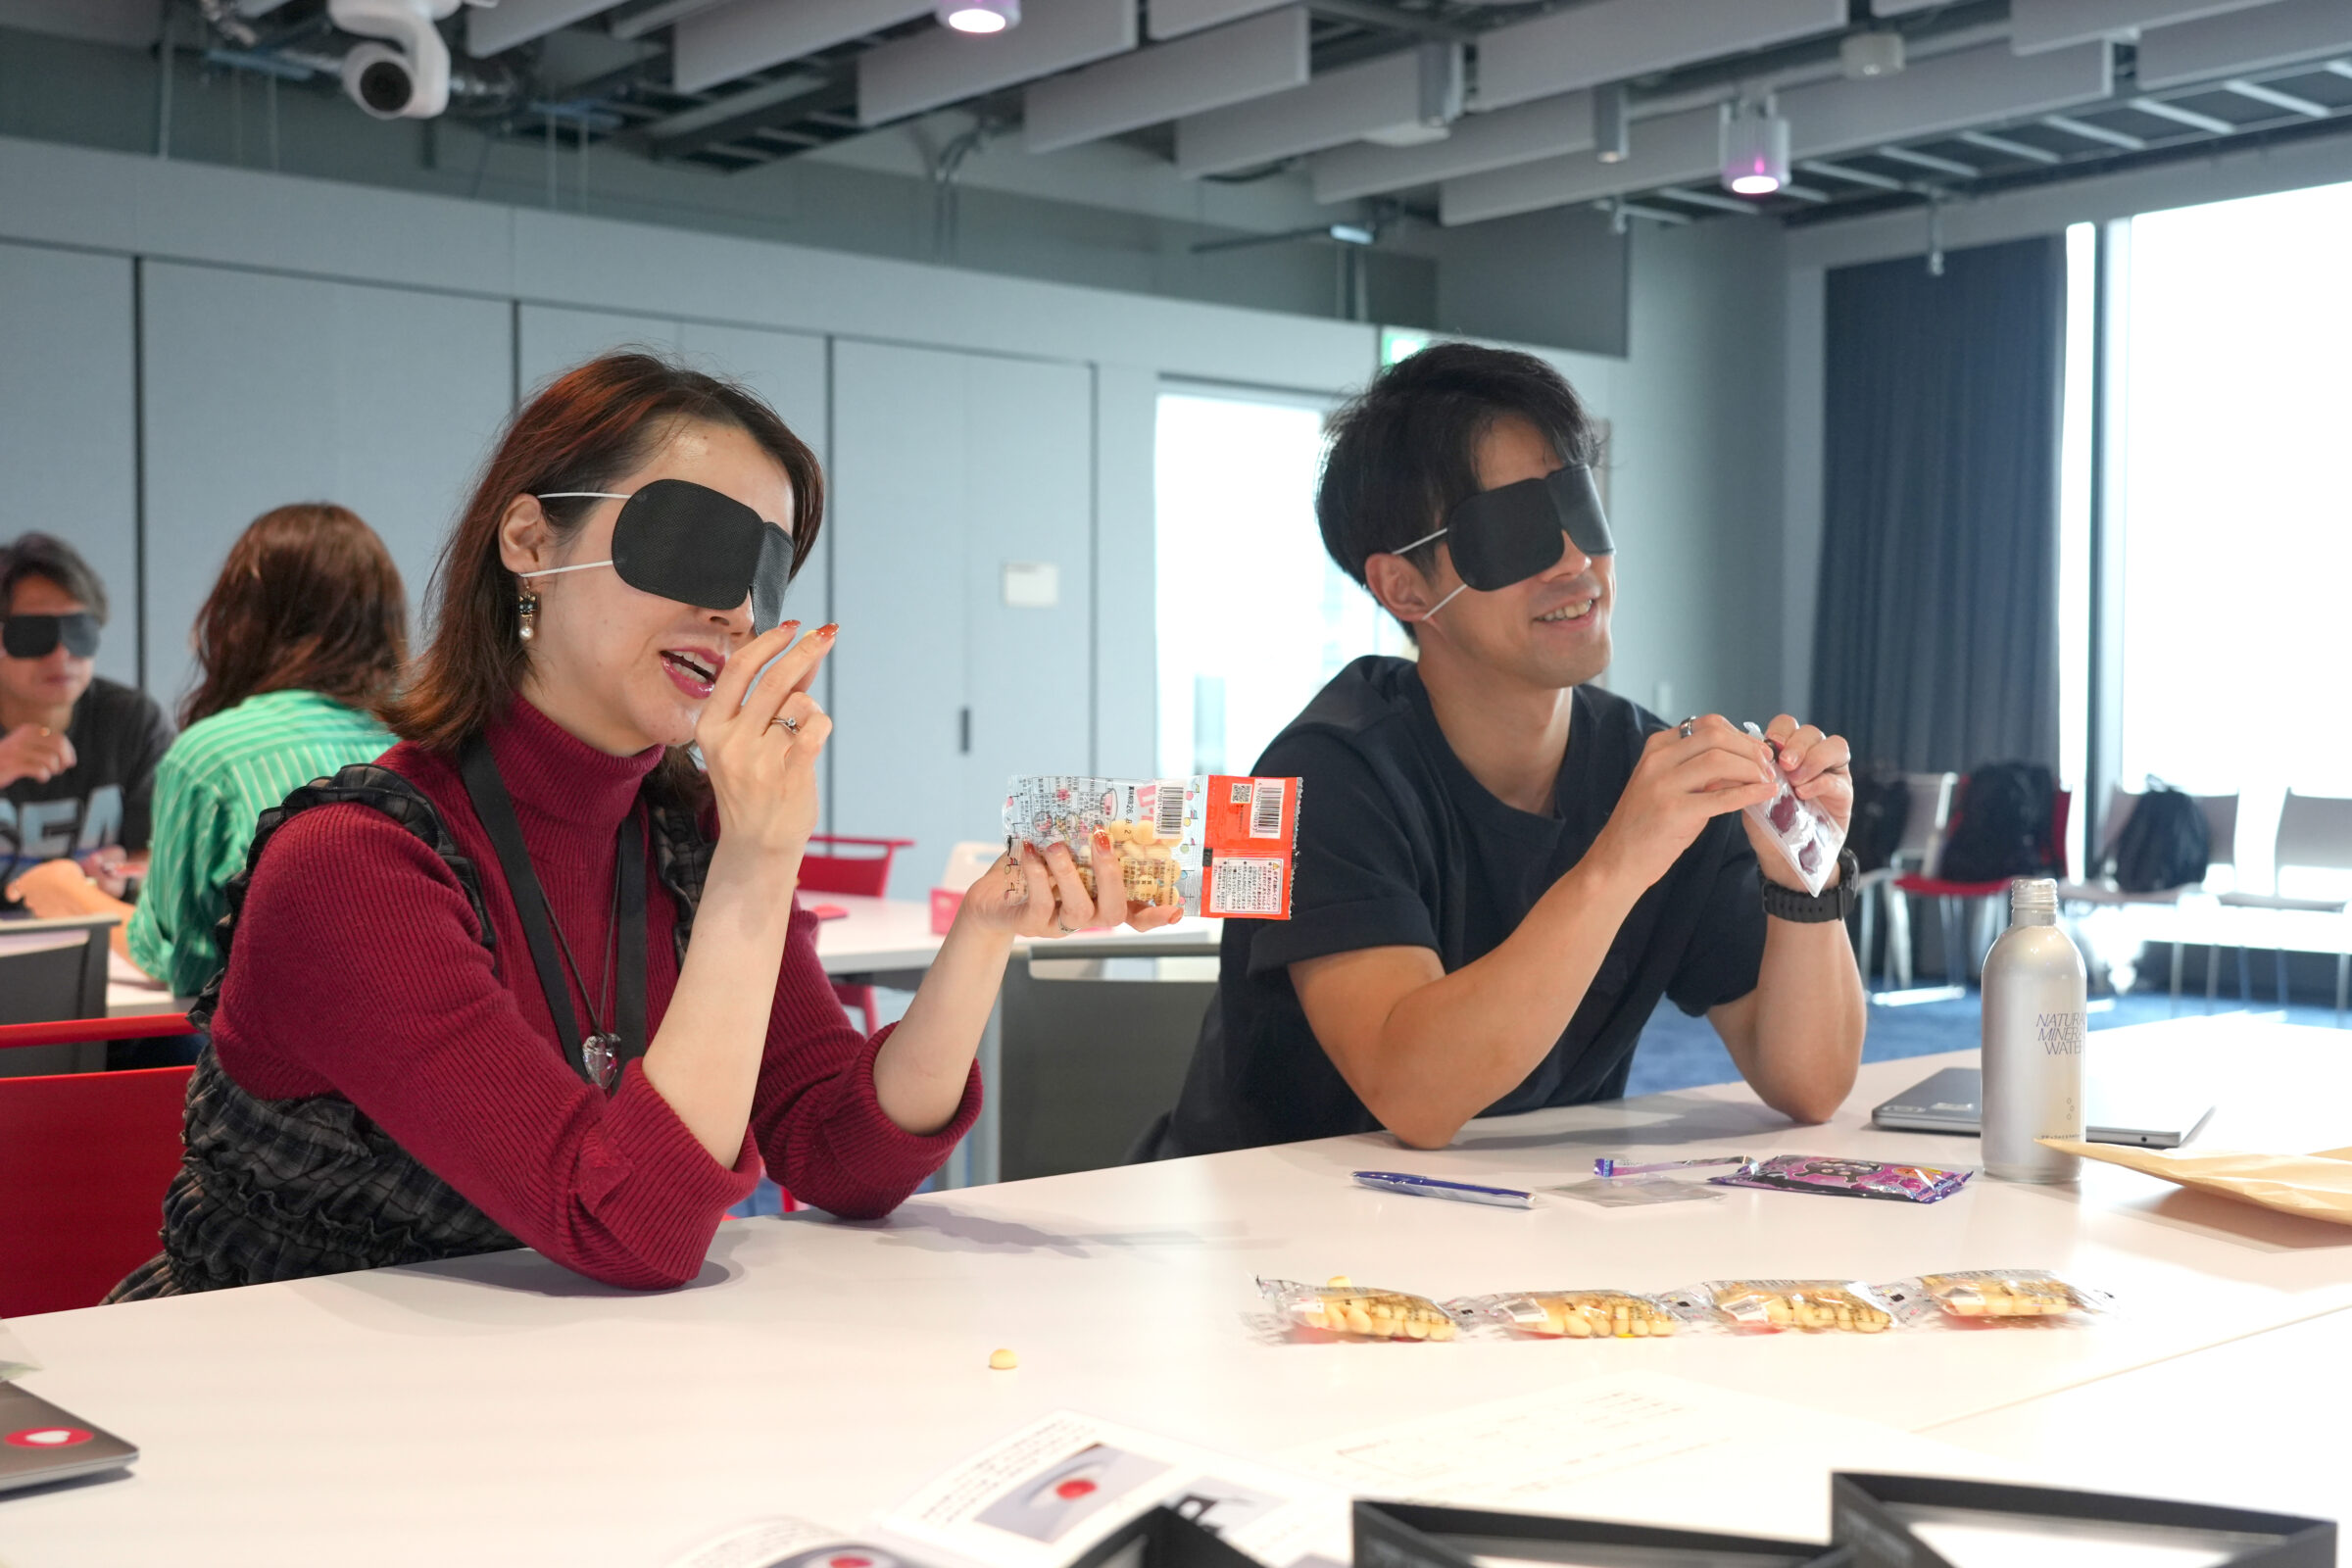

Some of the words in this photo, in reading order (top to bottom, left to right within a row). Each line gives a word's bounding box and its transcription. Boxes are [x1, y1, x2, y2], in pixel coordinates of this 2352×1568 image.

[2035, 1012, 2085, 1027] NATURA
[2037, 1027, 2085, 1041] MINERA
[2044, 1040, 2084, 1055] WATE
